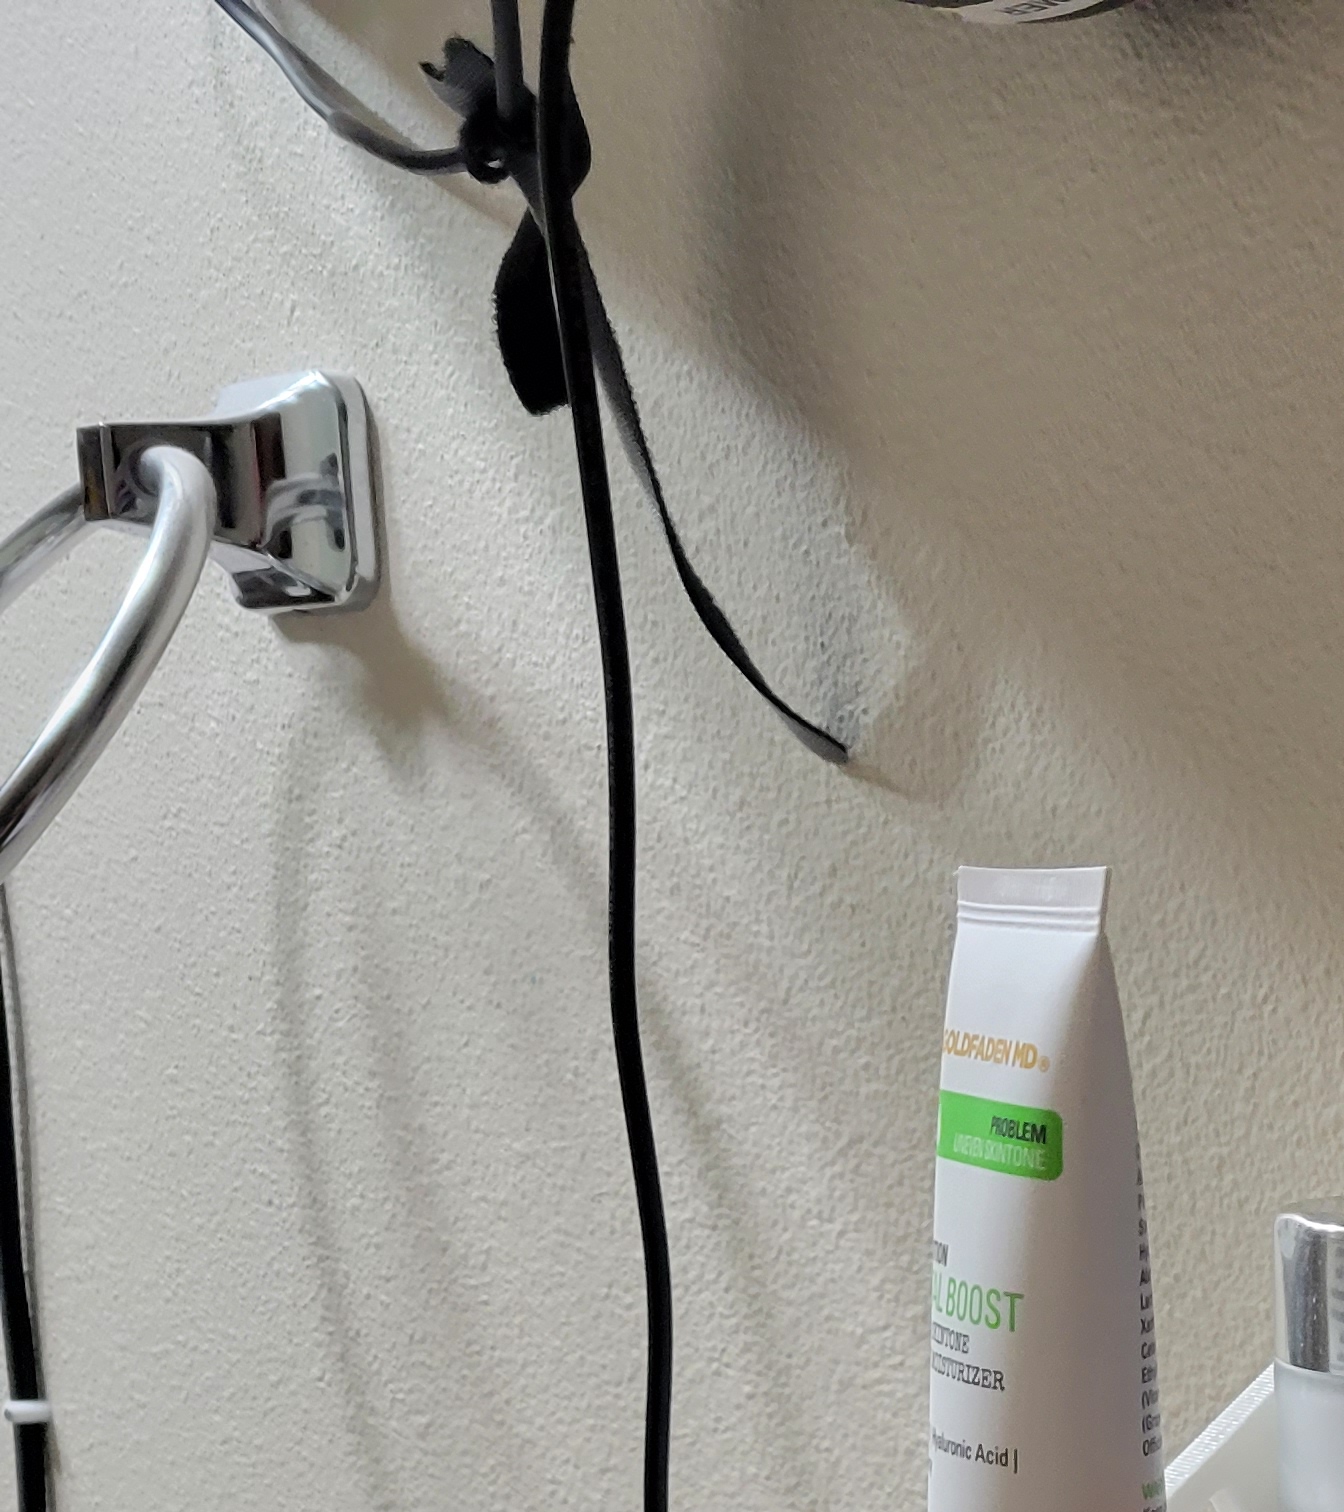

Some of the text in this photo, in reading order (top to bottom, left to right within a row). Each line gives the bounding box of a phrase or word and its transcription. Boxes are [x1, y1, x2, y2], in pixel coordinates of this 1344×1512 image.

[988, 1114, 1048, 1145] PROBLEM
[946, 1276, 1025, 1333] BOOST
[974, 1443, 1009, 1468] Acid
